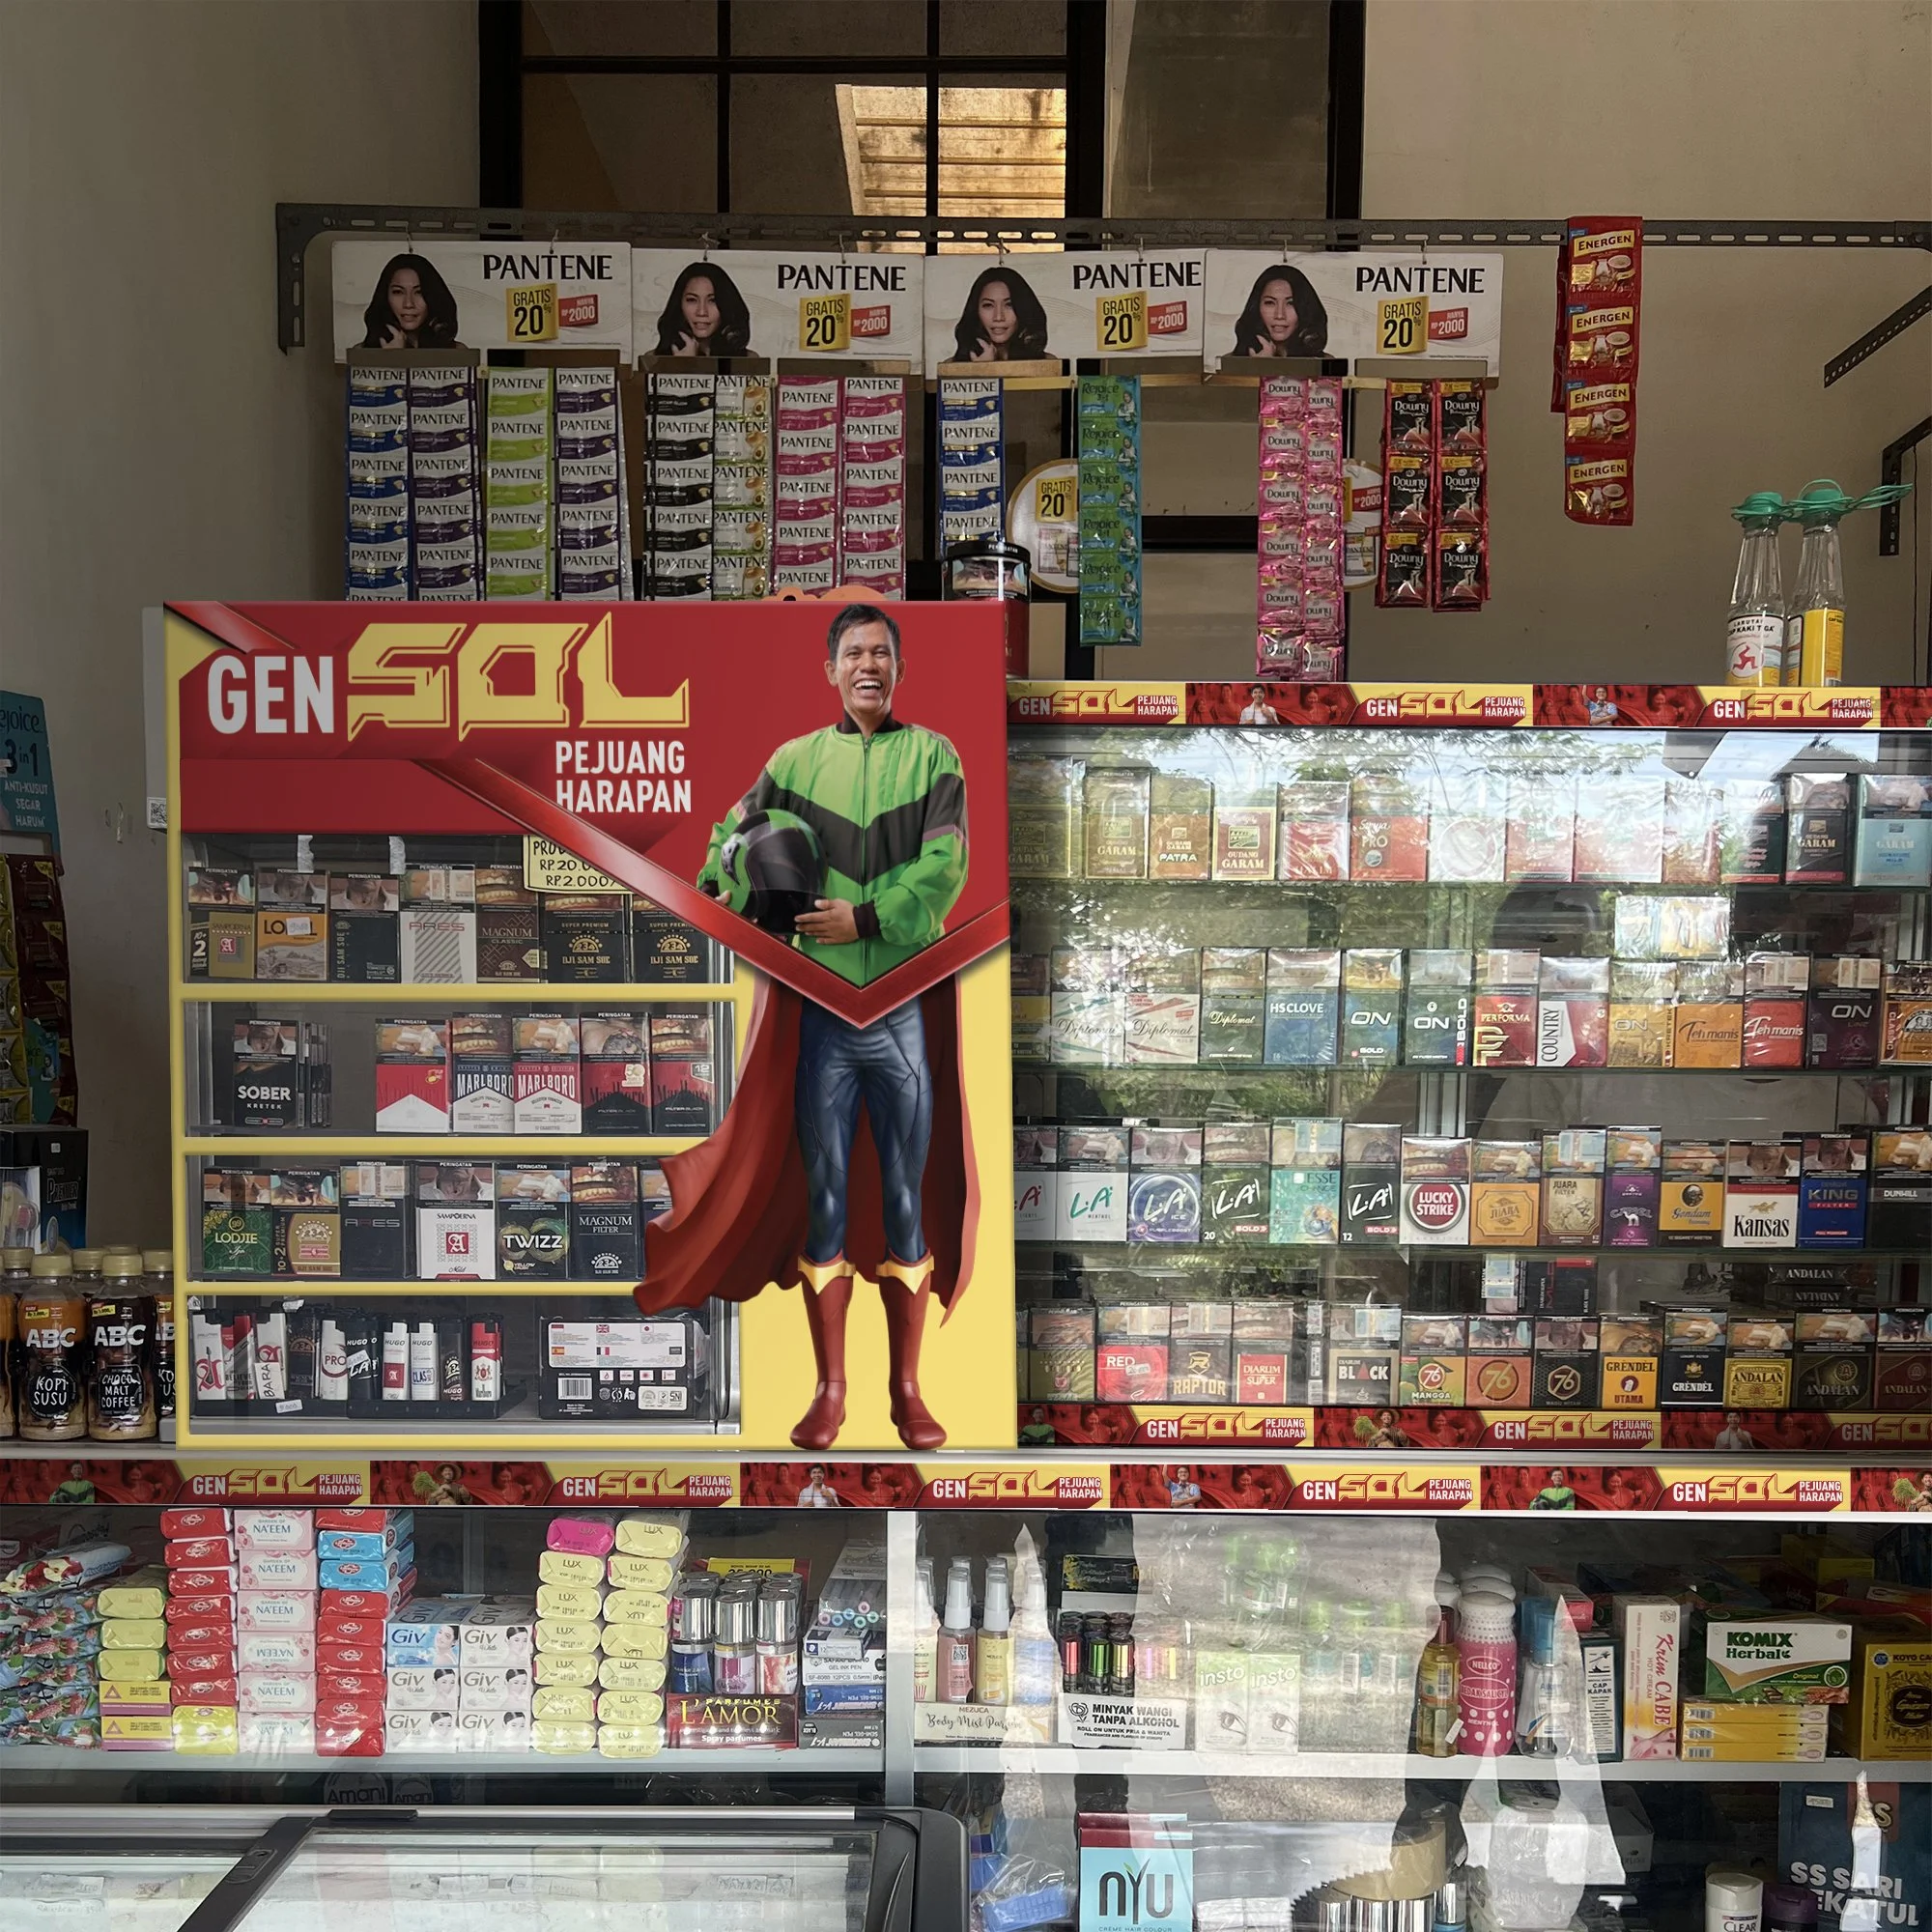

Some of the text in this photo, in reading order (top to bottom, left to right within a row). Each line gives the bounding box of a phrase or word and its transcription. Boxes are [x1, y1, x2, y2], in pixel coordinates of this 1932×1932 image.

[1578, 235, 1632, 251] ENERGEN
[483, 255, 612, 280] PANTENE
[778, 265, 906, 292] PANTENE
[1073, 262, 1202, 289] PANTENE
[1355, 267, 1485, 294] PANTENE
[513, 289, 552, 306] GRATIS
[807, 299, 844, 316] GRATIS
[1102, 296, 1141, 316] GRATIS
[1383, 300, 1421, 320] GRATIS
[412, 369, 465, 381] PANTENE
[492, 377, 545, 389] PANTENE
[659, 378, 711, 388] PANTENE
[943, 382, 997, 393] PANTENE
[1268, 383, 1300, 395] Downy
[781, 392, 834, 404] PANTENE
[1394, 400, 1429, 414] Downy
[1444, 399, 1480, 414] Downy
[1574, 464, 1625, 479] ENERGEN
[1138, 696, 1177, 705] PEJUANG
[1485, 697, 1524, 707] PEJUANG
[1138, 705, 1179, 715] HARAPAN
[1485, 707, 1526, 717] HARAPAN
[555, 741, 685, 775] PEJUANG
[5, 781, 47, 794] ANTI-KUSUT
[555, 780, 692, 813] HARAPAN
[15, 799, 41, 810] SEGAR
[15, 815, 45, 828] HARUM
[1159, 853, 1197, 862] PATRA
[1222, 859, 1264, 869] GARAM
[483, 928, 532, 937] MAGNUM
[1481, 1013, 1530, 1022] PERFORMA
[1832, 1005, 1872, 1018] ON
[1209, 1010, 1256, 1027] Diplomat
[1414, 1017, 1449, 1029] ON
[1457, 998, 1467, 1041] BOLD
[1542, 1009, 1559, 1062] COUNTRY
[1773, 1025, 1804, 1037] manis
[457, 1074, 514, 1098] MARLBORO
[518, 1074, 575, 1098] MARLBORO
[238, 1086, 291, 1100] SOBER
[1307, 1173, 1337, 1183] ESSE
[1419, 1192, 1453, 1203] LUCKY
[1808, 1188, 1859, 1200] KING
[1416, 1204, 1454, 1215] STRIKE
[580, 1216, 632, 1226] MAGNUM
[1734, 1214, 1789, 1237] Kansas
[215, 1233, 258, 1243] LODJIE
[503, 1236, 562, 1249] TWIZZ
[1787, 1268, 1833, 1279] ANDALAN
[26, 1328, 76, 1348] ABC
[95, 1324, 146, 1347] ABC
[1107, 1356, 1135, 1367] RED
[1733, 1372, 1784, 1383] ANDALAN
[105, 1385, 128, 1396] MALT
[1173, 1378, 1227, 1396] RAPTOR
[1805, 1384, 1860, 1396] ANDALAN
[34, 1391, 67, 1406] SUSU
[101, 1396, 135, 1407] COFFEE
[1614, 1395, 1643, 1405] UTAMA
[1265, 1418, 1304, 1428] PEJUANG
[1265, 1429, 1306, 1438] HARAPAN
[1060, 1477, 1101, 1488] PEJUANG
[1799, 1481, 1841, 1492] PEJUANG
[1060, 1489, 1103, 1498] HARAPAN
[1799, 1492, 1843, 1502] HARAPAN
[562, 1559, 582, 1569] LUX
[391, 1629, 427, 1645] Giv
[1726, 1632, 1792, 1647] KOMIX
[1726, 1648, 1780, 1660] Herbal
[1200, 1666, 1245, 1687] insto
[1251, 1667, 1296, 1688] insto
[1654, 1634, 1674, 1725] Krim CABE
[1093, 1704, 1173, 1716] MINYAK WANGI
[927, 1714, 953, 1727] Body
[1093, 1715, 1179, 1728] TANPA ALKOHOL
